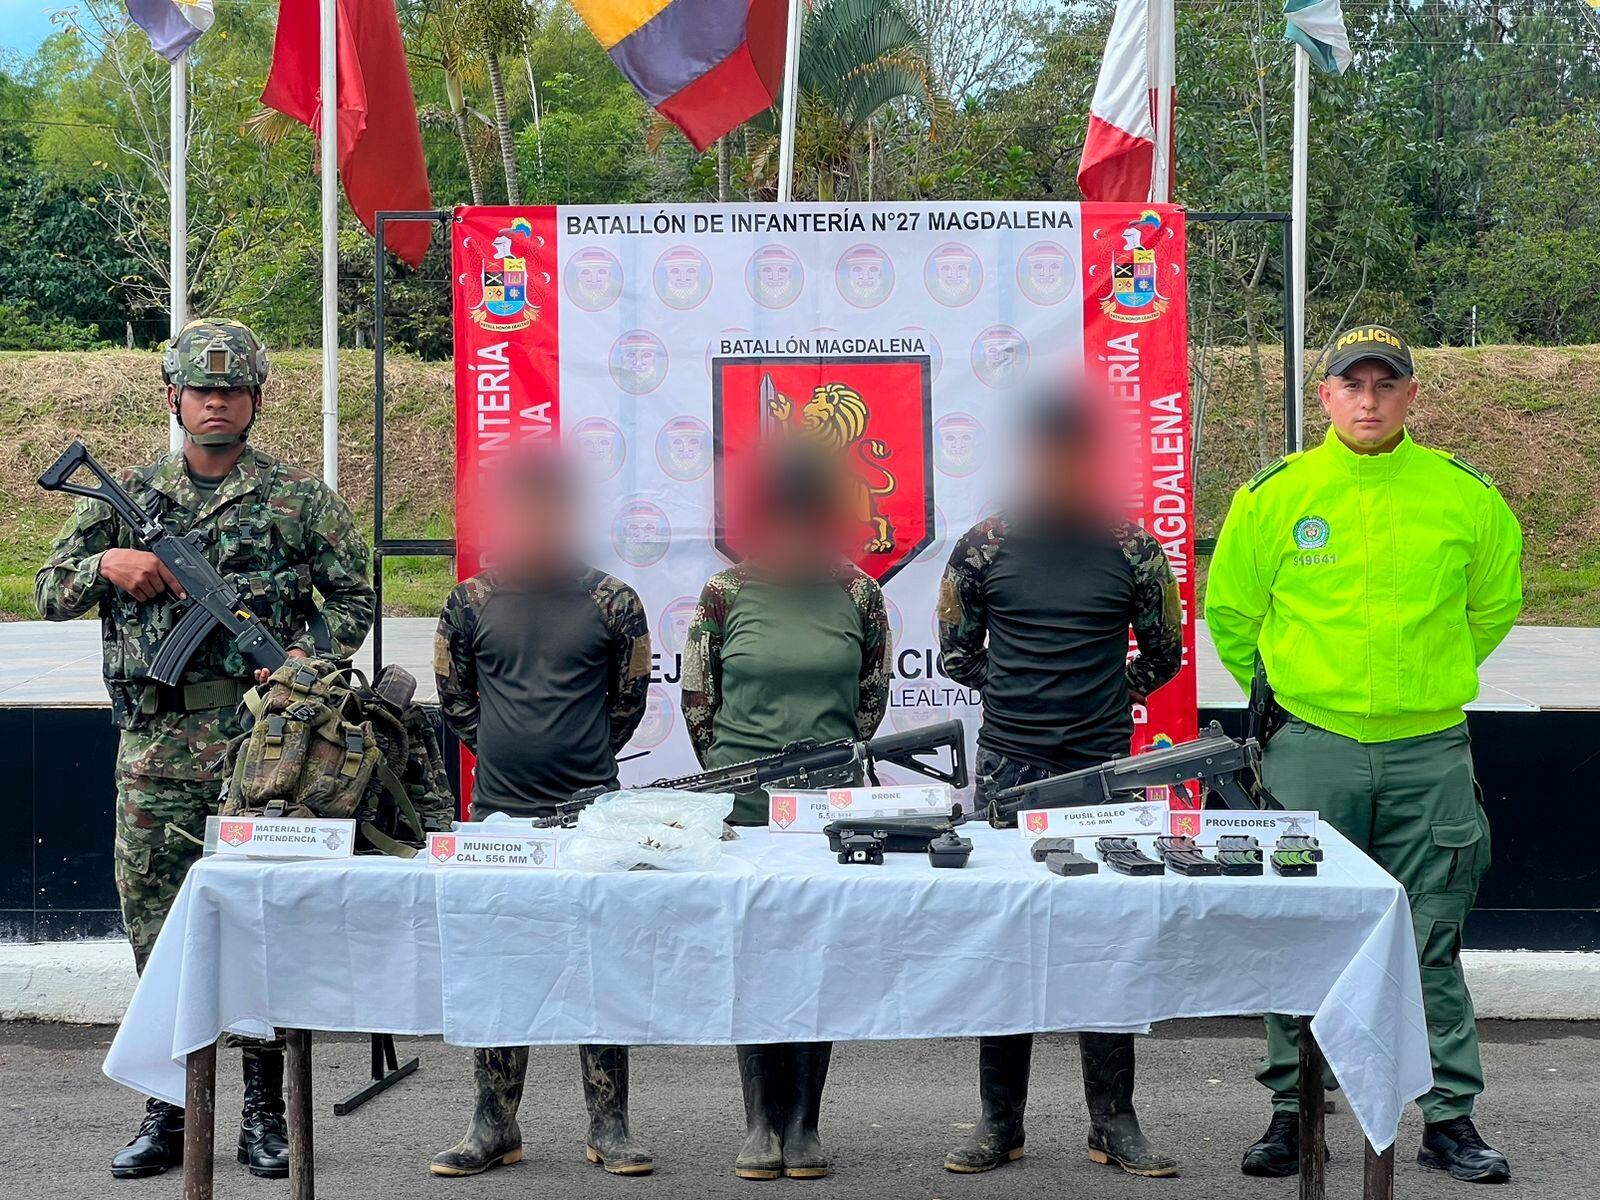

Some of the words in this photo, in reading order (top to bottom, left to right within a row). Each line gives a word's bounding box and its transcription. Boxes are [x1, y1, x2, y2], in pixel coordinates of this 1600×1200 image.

[567, 210, 686, 235] BATALLÓN
[694, 214, 724, 233] DE
[731, 208, 866, 233] INFANTERÍA
[928, 210, 1074, 231] MAGDALENA
[720, 336, 810, 354] BATALLÓN
[816, 338, 925, 353] MAGDALENA
[890, 688, 982, 708] LEALTAD
[871, 793, 901, 801] DRONE
[1097, 810, 1126, 818] GALEO
[1205, 818, 1277, 828] PROVEDORES
[255, 825, 302, 833] MATERIAL
[304, 826, 317, 834] DE
[253, 834, 317, 843] INTENDENCIA
[463, 842, 522, 852] MUNICION
[456, 853, 482, 862] CAL.
[486, 854, 505, 863] 556
[508, 855, 528, 864] MM
